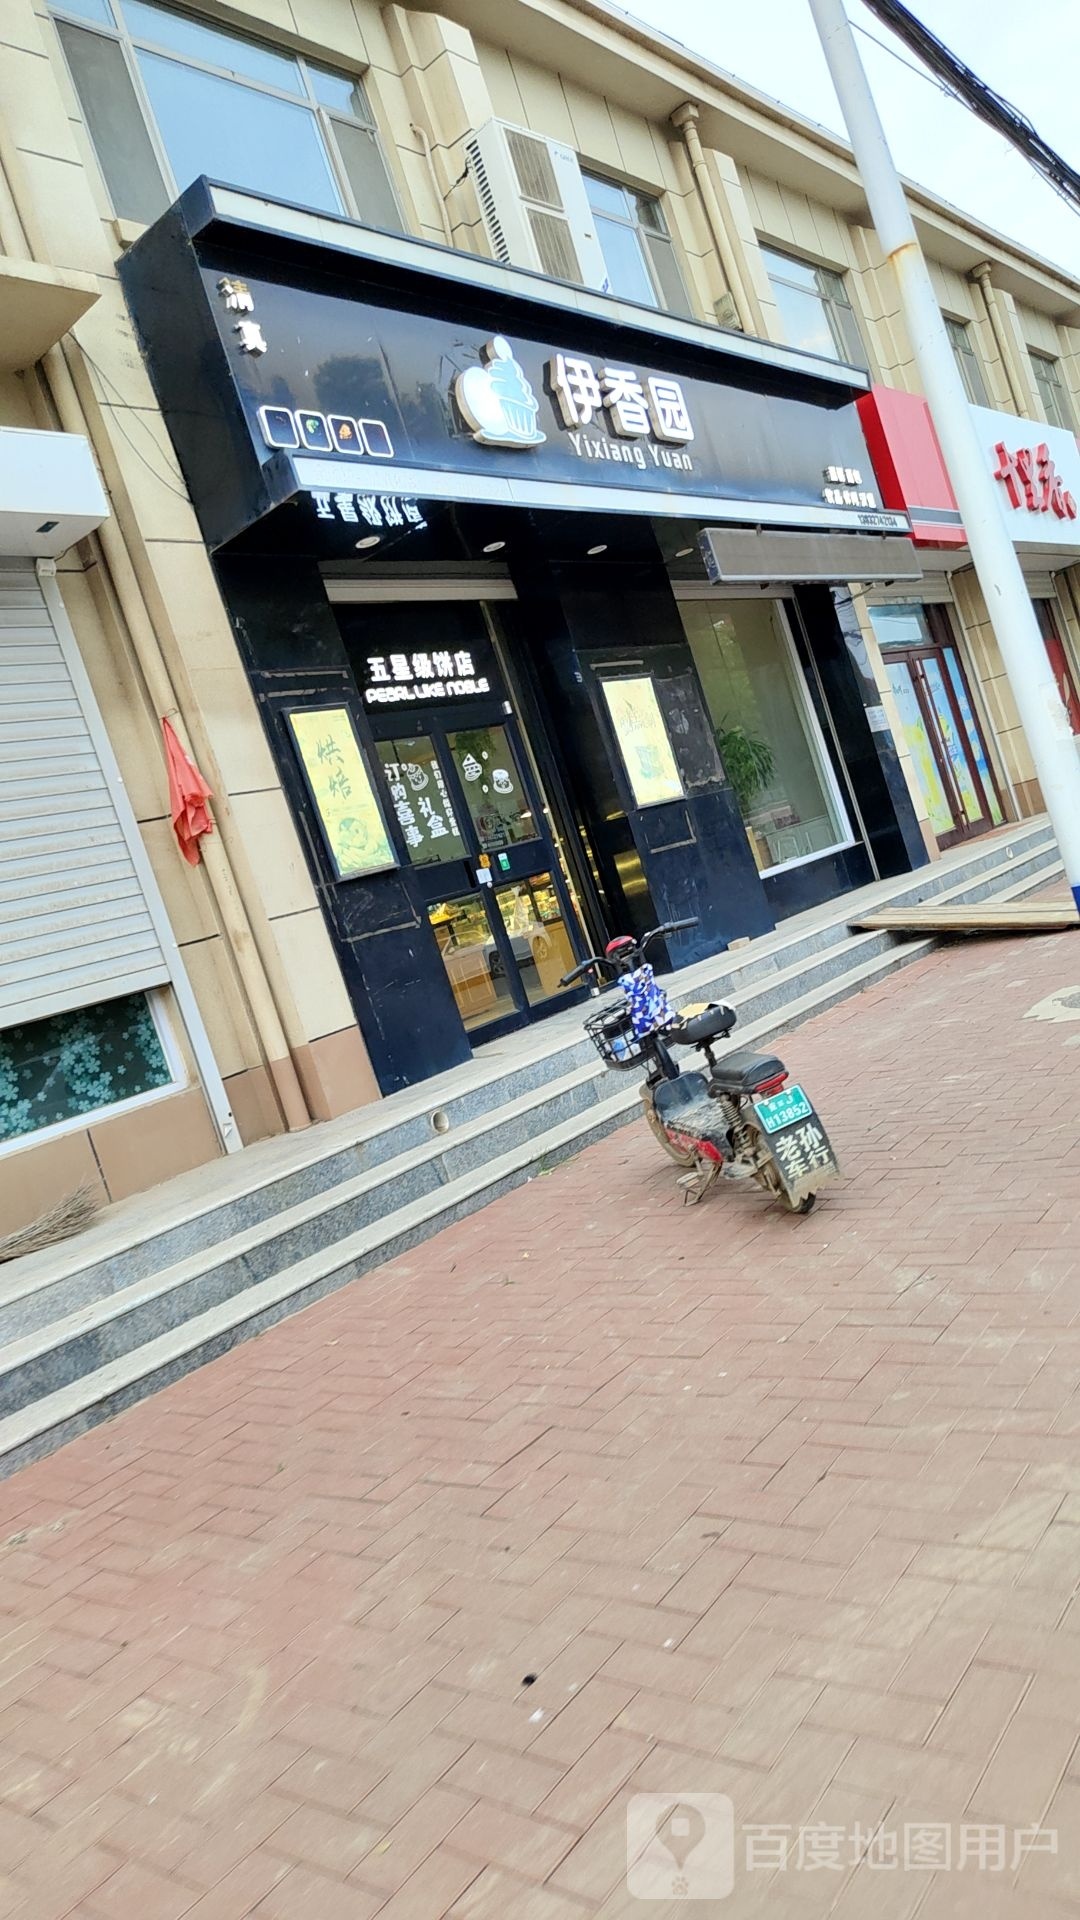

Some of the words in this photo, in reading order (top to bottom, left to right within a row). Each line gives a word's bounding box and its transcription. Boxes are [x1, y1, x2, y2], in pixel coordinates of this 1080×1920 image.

[553, 353, 694, 442] 伊香园
[568, 432, 647, 470] Yixiang
[648, 448, 693, 471] Yuan
[367, 650, 475, 682] 五星级饼店
[413, 682, 446, 699] LIKE
[315, 734, 352, 800] 烘焙
[775, 1122, 823, 1161] 老孙
[784, 1145, 829, 1178] 车行
